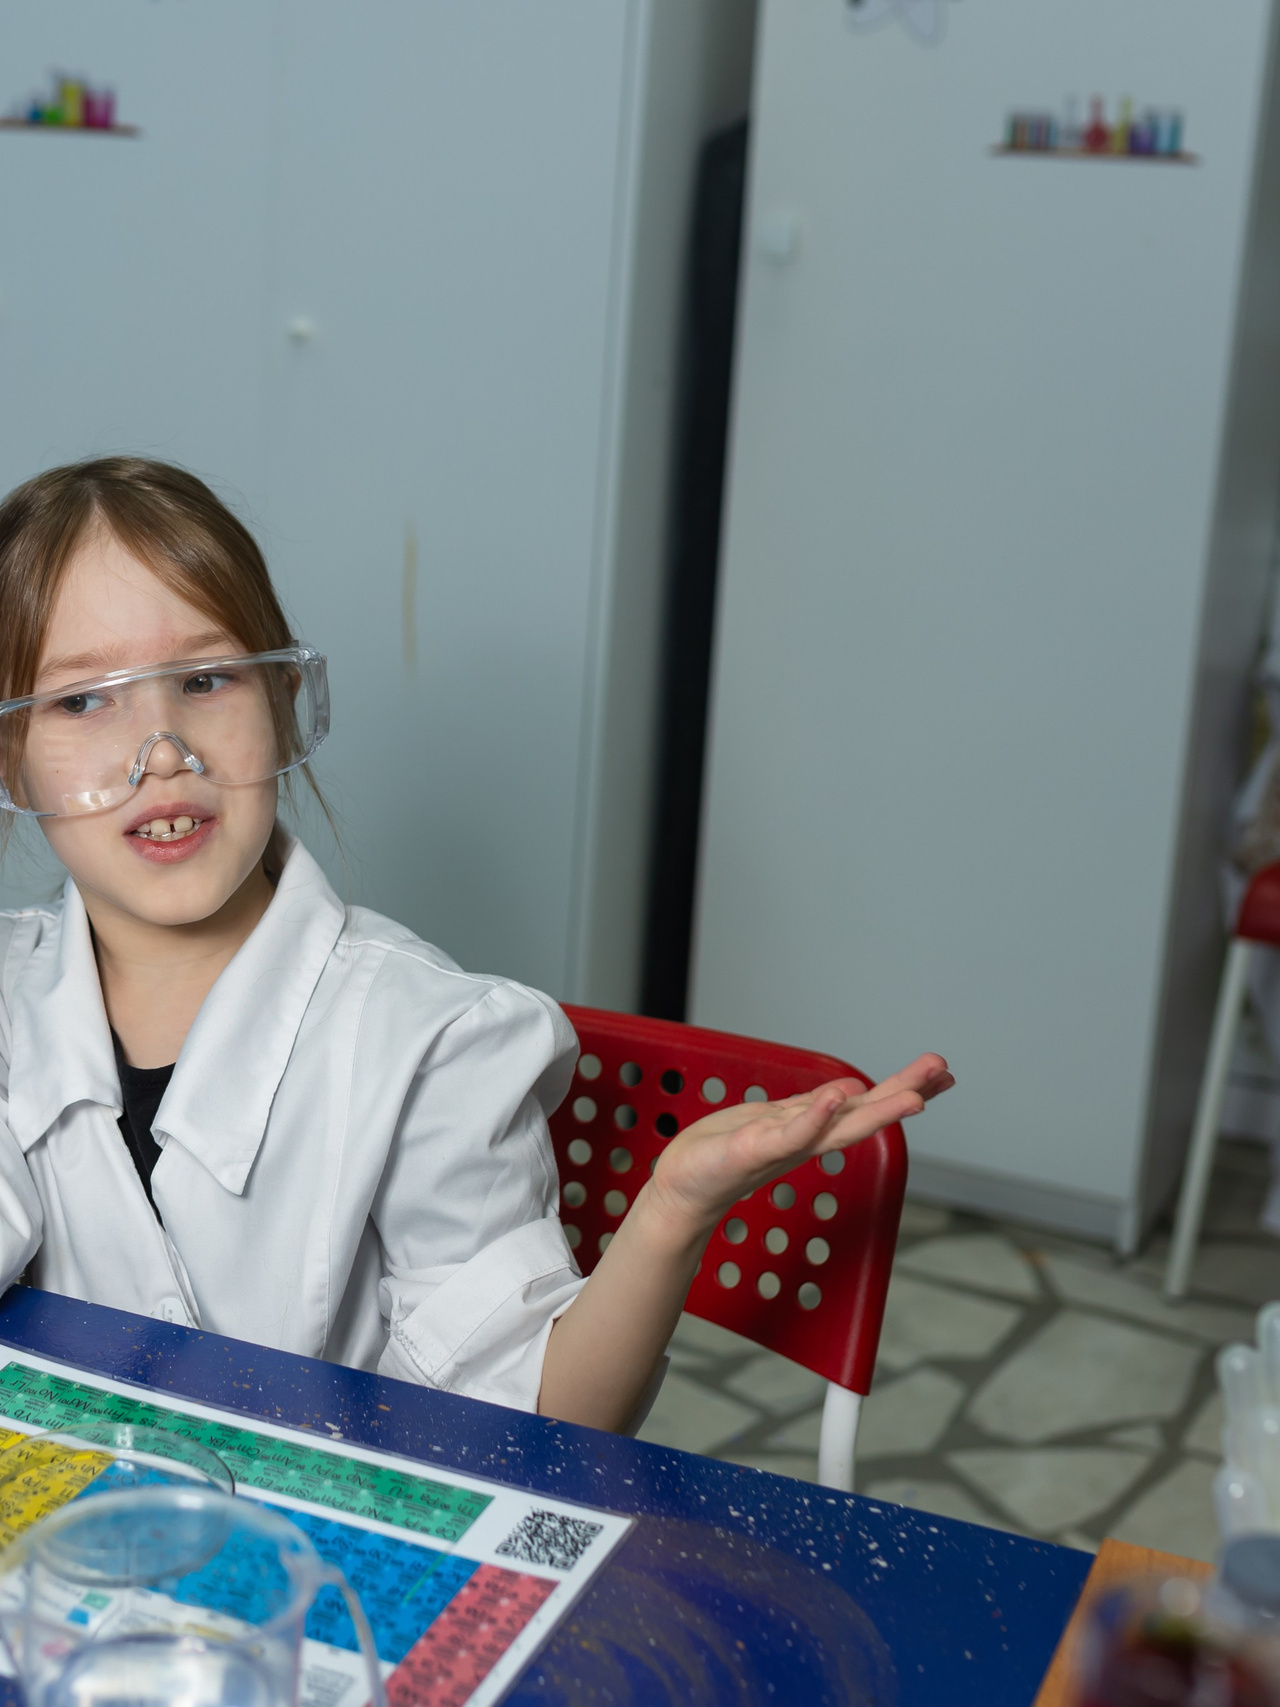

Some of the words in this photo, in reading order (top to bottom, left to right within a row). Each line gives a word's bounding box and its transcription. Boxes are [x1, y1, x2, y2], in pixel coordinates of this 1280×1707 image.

[9, 1379, 27, 1390] Lr
[38, 1389, 60, 1400] No
[65, 1398, 92, 1410] Md
[13, 1409, 32, 1421] Yb
[99, 1407, 125, 1420] Fm
[45, 1418, 65, 1430] Tm
[138, 1417, 157, 1428] Es
[174, 1427, 192, 1438] Cf
[209, 1436, 226, 1448] Bk
[272, 1453, 295, 1466] Am
[80, 1463, 96, 1476] Nh
[311, 1464, 331, 1476] Pu
[253, 1476, 274, 1488] Eu
[346, 1473, 367, 1486] Np
[284, 1484, 310, 1498] Sm
[317, 1494, 346, 1508] Pm
